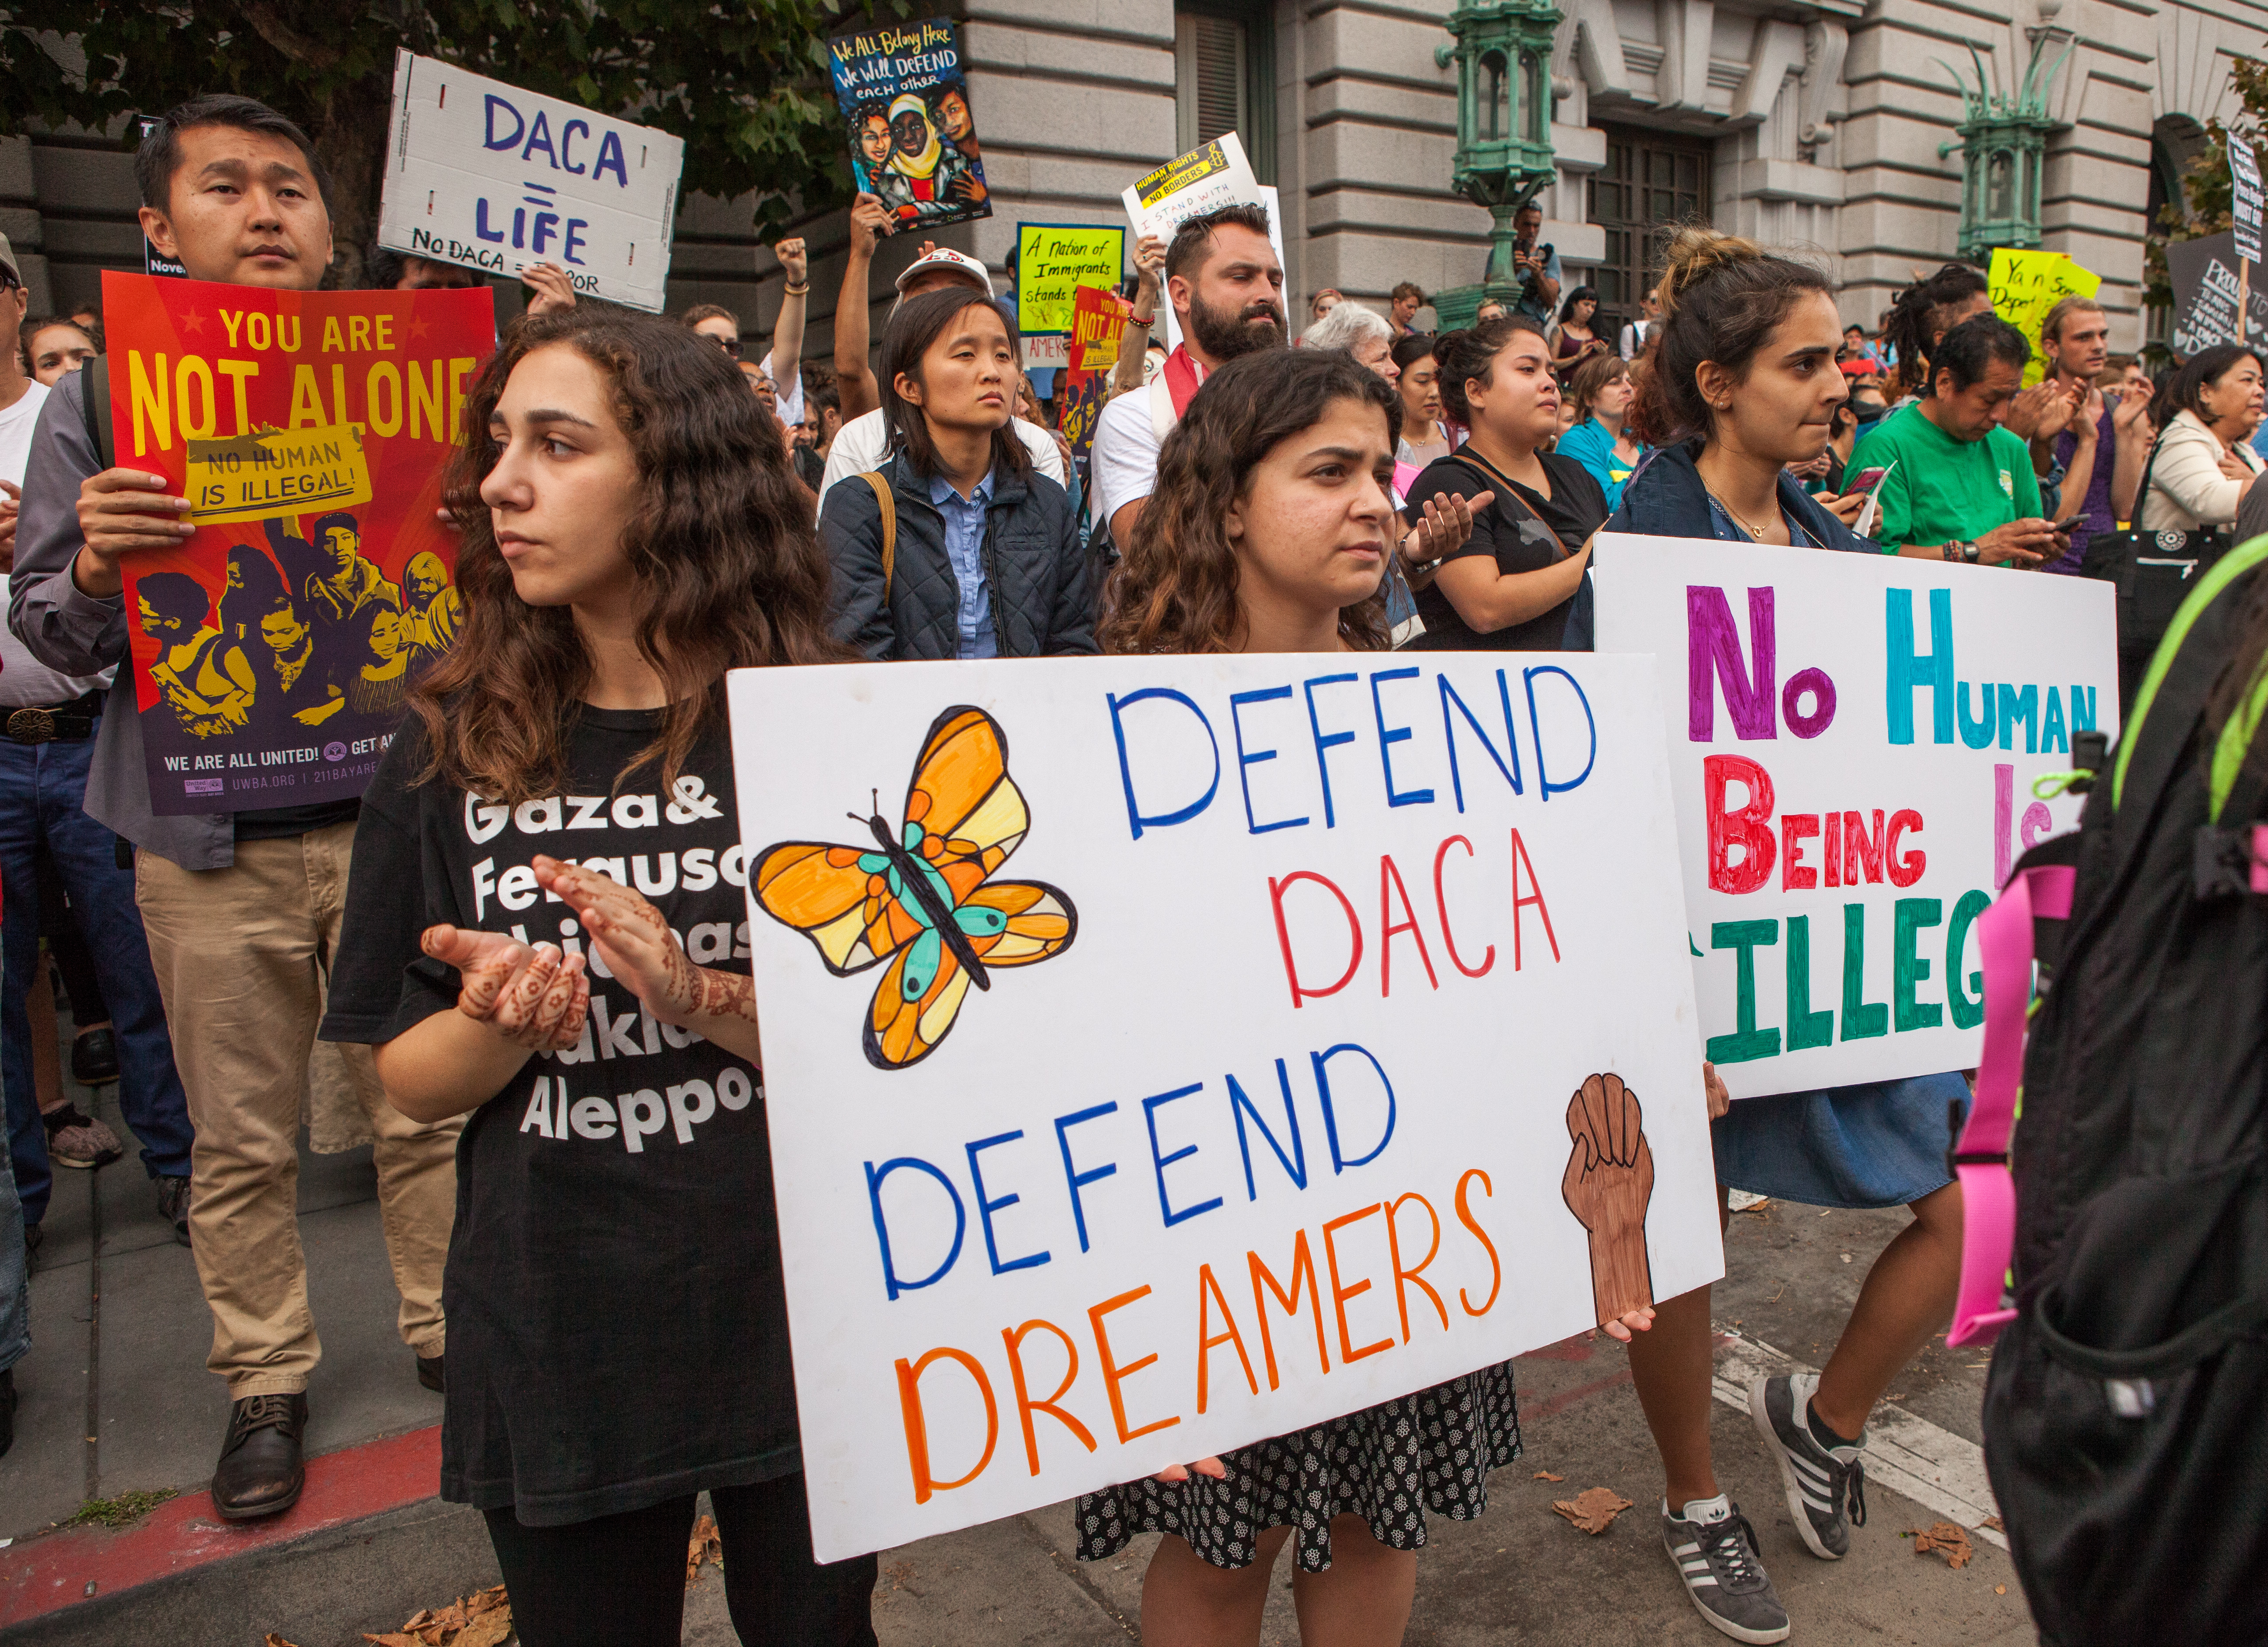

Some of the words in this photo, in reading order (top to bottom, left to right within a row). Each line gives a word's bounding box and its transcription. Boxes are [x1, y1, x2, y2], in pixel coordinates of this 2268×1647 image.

[833, 40, 855, 62] We
[836, 67, 860, 88] We
[859, 58, 894, 82] Will
[484, 94, 628, 188] DACA
[1136, 167, 1167, 190] HUMAN
[1167, 151, 1199, 172] RIGHTS
[1149, 191, 1162, 204] NO
[1163, 166, 1203, 194] BORDERS
[1160, 170, 1176, 183] HAVE
[1141, 220, 1150, 231] I
[1155, 198, 1193, 221] STAND
[1198, 183, 1229, 201] WITH
[412, 227, 444, 254] NO
[449, 240, 504, 271] DACA
[476, 198, 588, 265] LIFE
[1026, 234, 1041, 257] A
[1092, 241, 1110, 256] of
[150, 260, 186, 274] Nove
[1034, 261, 1111, 282] Immigrants
[1101, 298, 1115, 314] YOU
[219, 309, 302, 352] YOU
[321, 314, 395, 352] ARE
[1075, 310, 1106, 345] NOT
[128, 349, 259, 458] NOT
[288, 357, 476, 447] ALONE
[208, 451, 241, 475] NO
[253, 442, 342, 472] HUMAN
[201, 481, 225, 506] IS
[242, 467, 356, 503] ILLEGAL!
[164, 756, 190, 771] WE
[195, 754, 224, 769] ARE
[230, 753, 257, 768] ALL
[261, 747, 319, 765] UNITED!
[352, 737, 376, 754] GET
[1106, 666, 1596, 841] DEFEND
[233, 775, 295, 790] UWBA.ORG
[314, 760, 382, 783] 211BAYARE
[1268, 828, 1561, 1009] DACA
[1706, 889, 1992, 1065] ILLEG
[519, 1067, 764, 1153] Aleppo.
[863, 1043, 1396, 1301] DEFEND
[894, 1168, 1501, 1505] DREAMERS
